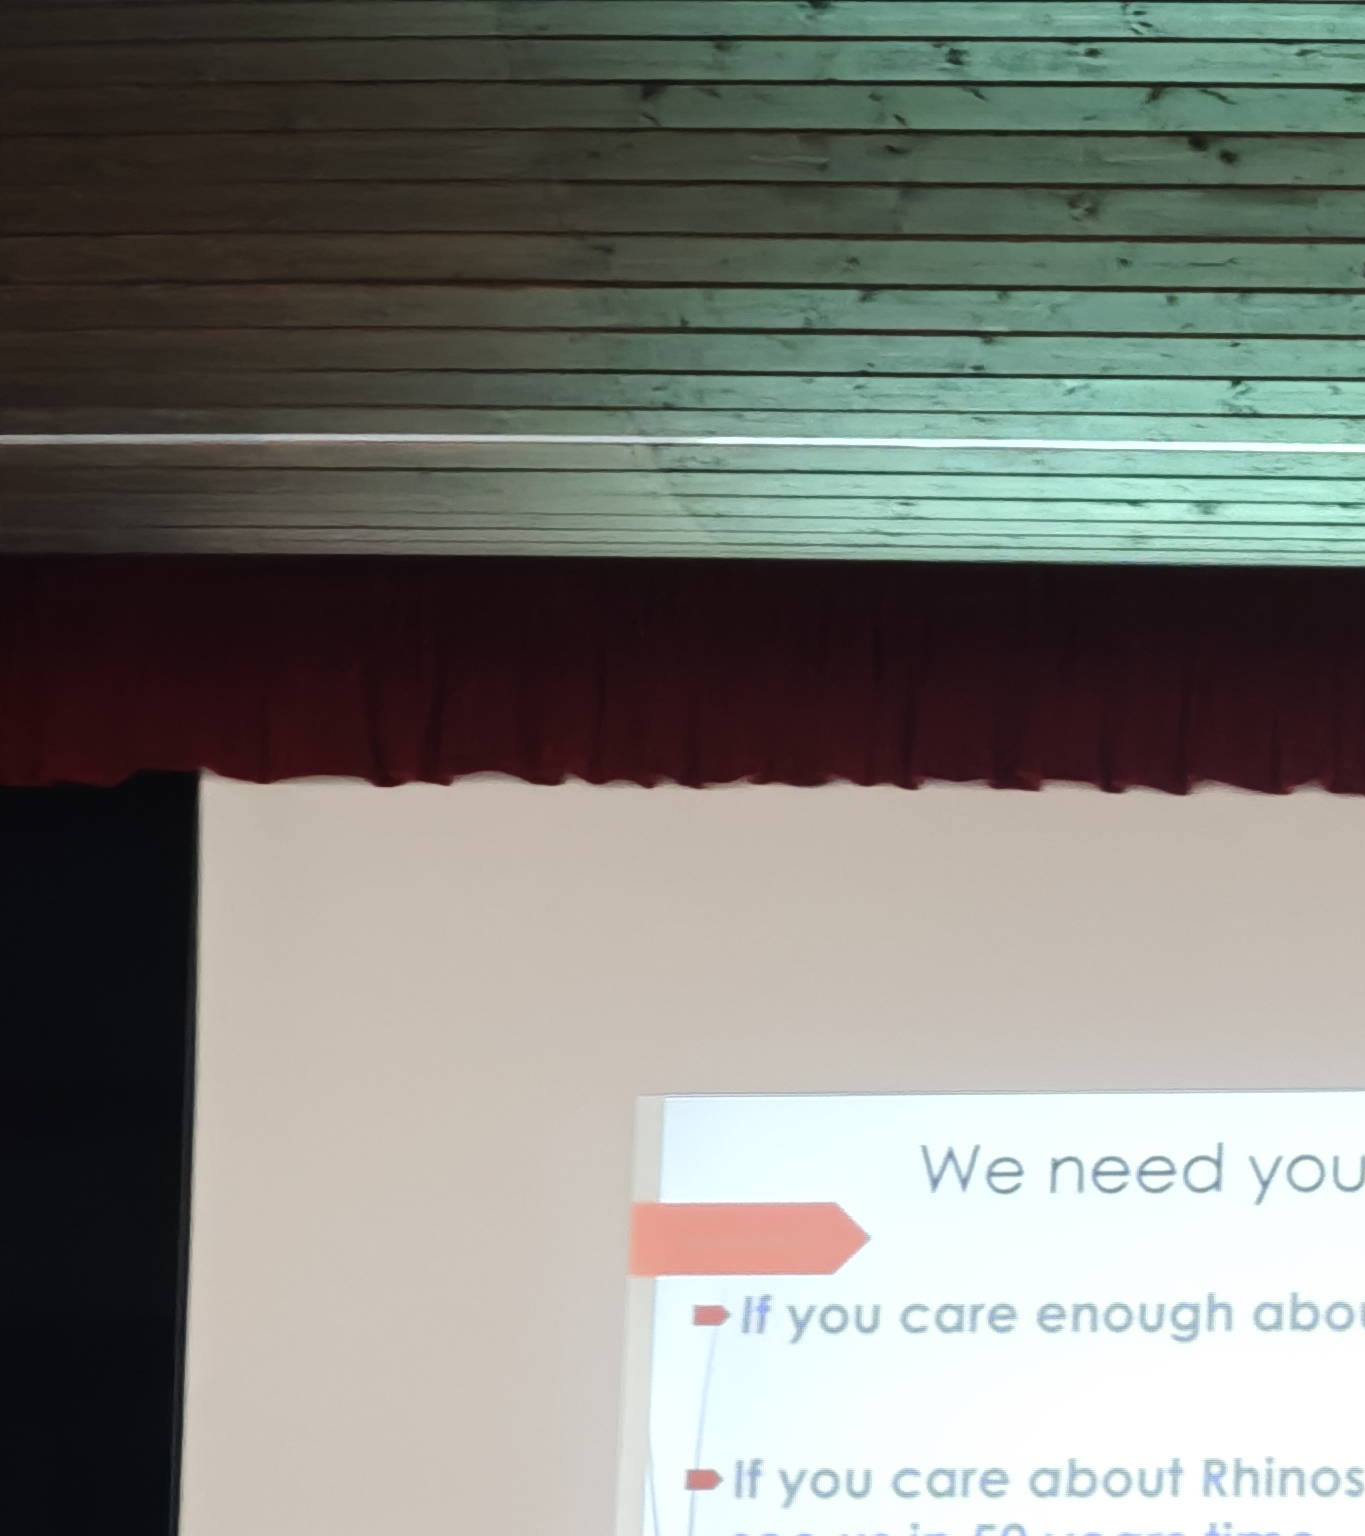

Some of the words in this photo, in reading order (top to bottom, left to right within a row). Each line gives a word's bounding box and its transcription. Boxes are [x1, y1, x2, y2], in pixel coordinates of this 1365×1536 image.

[920, 1143, 1025, 1195] We
[1050, 1142, 1224, 1194] need
[739, 1294, 773, 1335] If
[787, 1303, 881, 1344] you
[900, 1303, 1018, 1334] care
[1036, 1292, 1234, 1344] enough
[734, 1458, 763, 1499] If
[779, 1468, 873, 1509] you
[890, 1468, 1010, 1499] care
[1028, 1458, 1184, 1499] about
[1202, 1456, 1365, 1498] Rhinos
